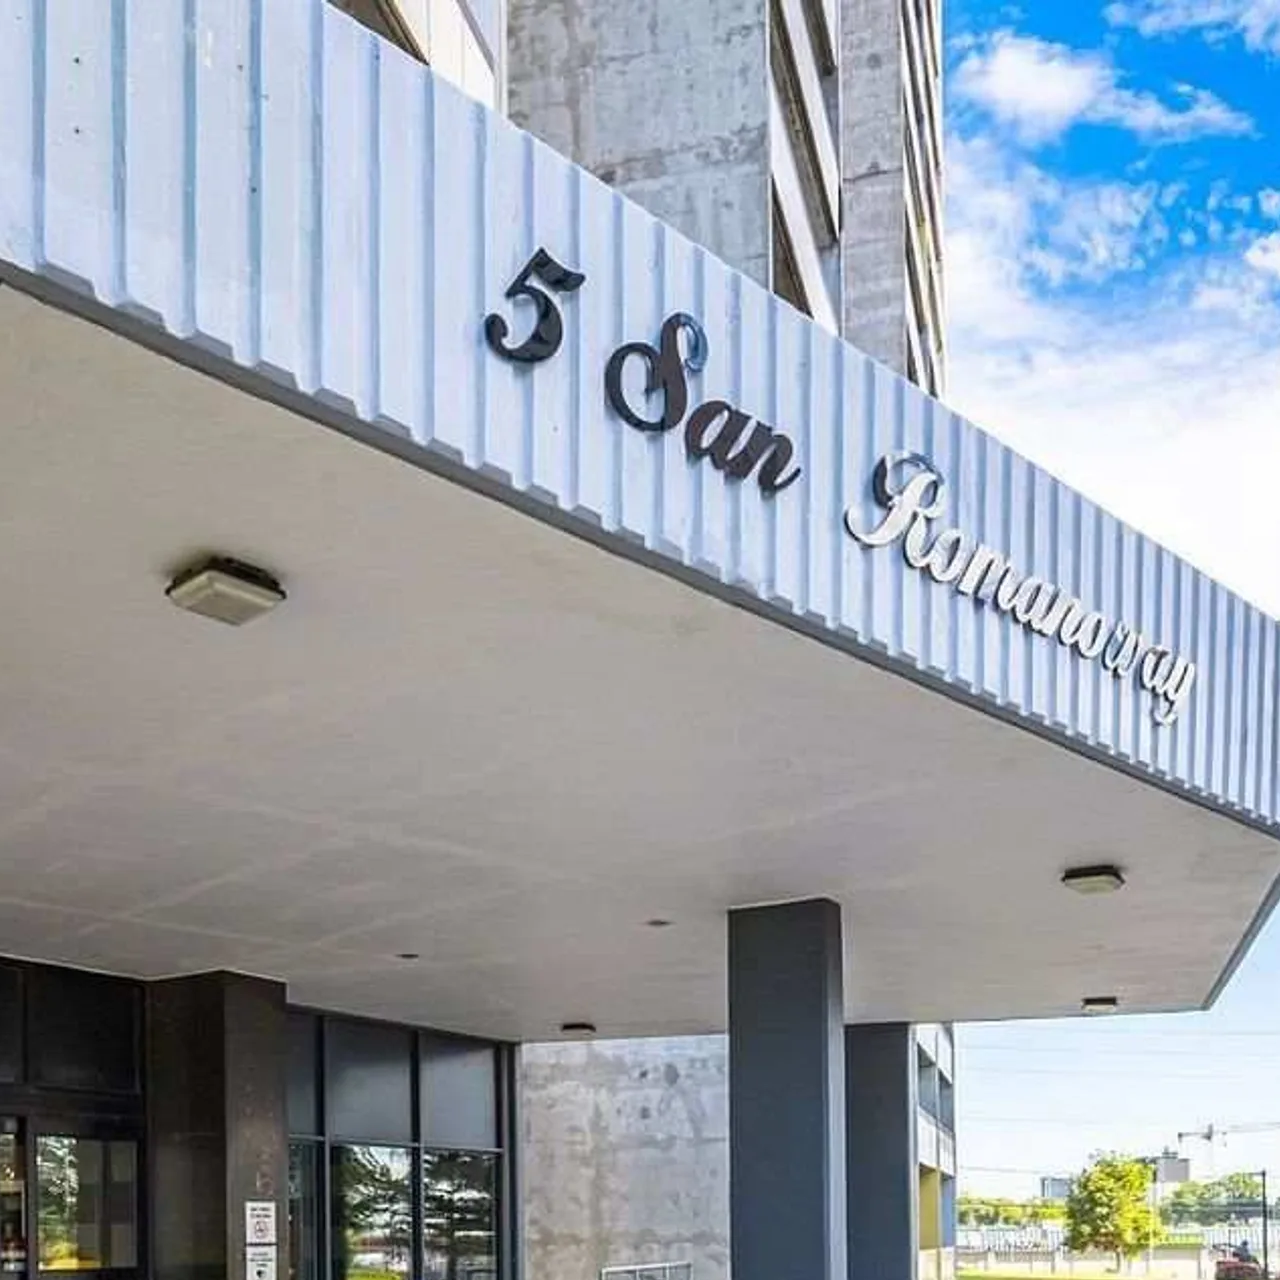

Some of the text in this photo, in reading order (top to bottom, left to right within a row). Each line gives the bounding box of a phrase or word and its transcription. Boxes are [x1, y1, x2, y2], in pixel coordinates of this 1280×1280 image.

[484, 247, 1197, 727] 5 San Romanoway
